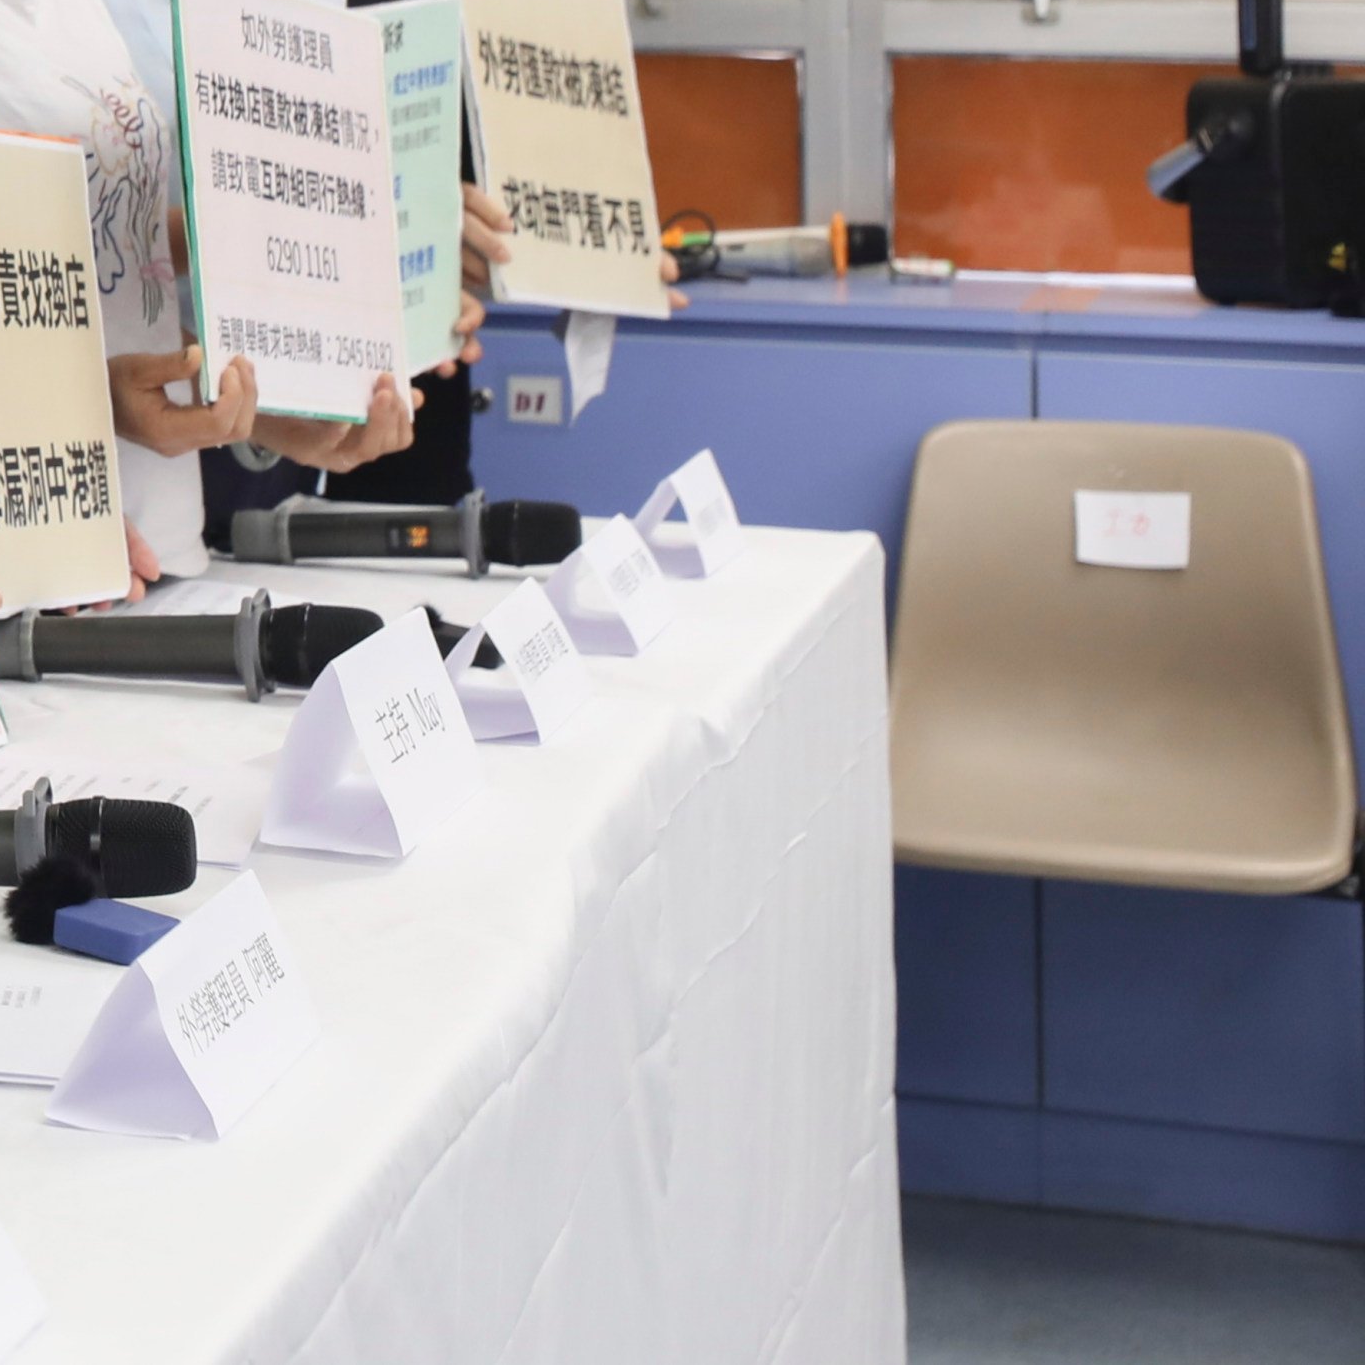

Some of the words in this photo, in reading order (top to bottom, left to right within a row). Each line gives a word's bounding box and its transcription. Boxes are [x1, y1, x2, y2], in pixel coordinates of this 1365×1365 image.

[240, 9, 334, 75] 如外勞護理員
[478, 29, 629, 118] 外勞匯款被凍結
[502, 174, 651, 257] 求助無門看不見
[266, 235, 302, 276] 6290
[306, 241, 340, 283] 1161
[410, 686, 447, 739] May
[175, 960, 255, 1059] 外勞護理員
